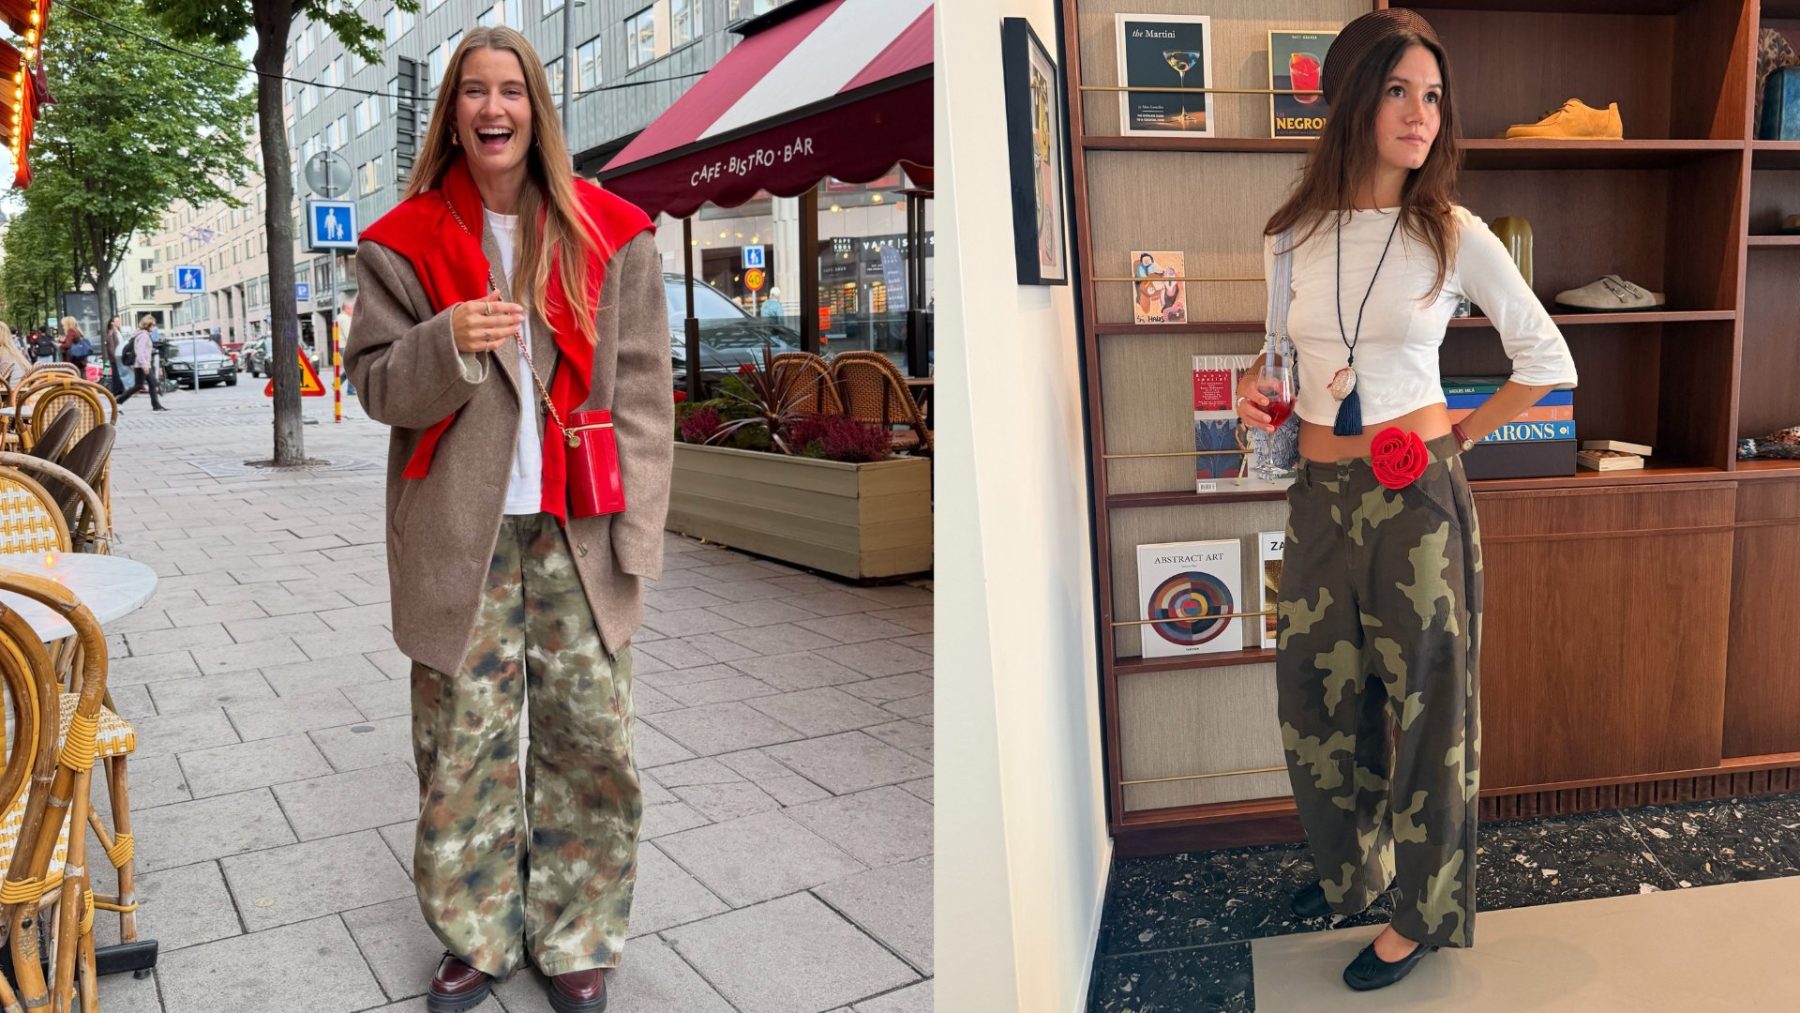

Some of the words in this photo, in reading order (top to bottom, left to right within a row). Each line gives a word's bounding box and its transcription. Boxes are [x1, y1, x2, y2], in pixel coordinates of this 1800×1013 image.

[1132, 29, 1143, 38] the
[1145, 29, 1176, 39] Martini
[690, 162, 721, 187] CAFE
[728, 148, 775, 177] BISTRO
[783, 136, 814, 163] BAR
[1484, 423, 1555, 442] ARONS
[1154, 554, 1203, 565] ABSTRACT
[1205, 552, 1224, 561] ART
